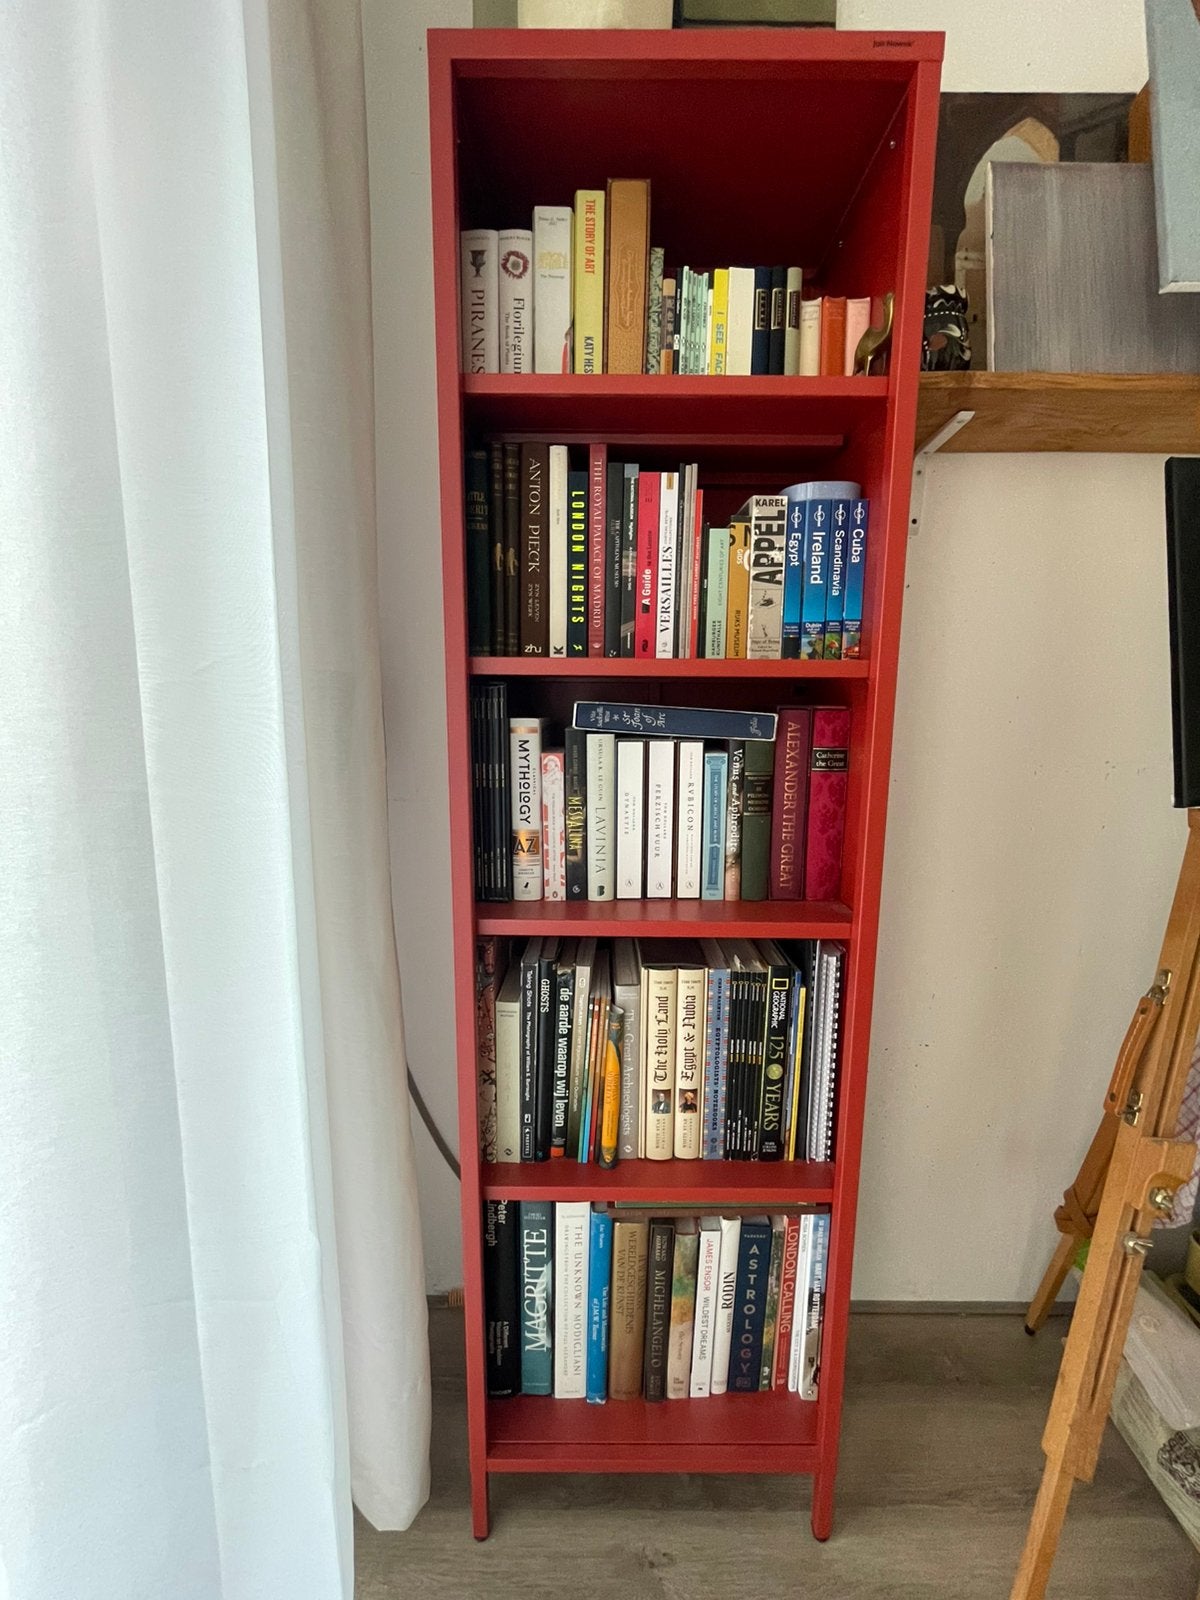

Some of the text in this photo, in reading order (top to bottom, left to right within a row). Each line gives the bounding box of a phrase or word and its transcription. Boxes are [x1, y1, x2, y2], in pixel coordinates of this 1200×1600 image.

[584, 199, 596, 275] THE STORY OF ART
[583, 336, 594, 357] KATY
[715, 323, 725, 345] SEE
[528, 458, 541, 573] ANTON PIECK
[755, 498, 786, 507] KAREL
[571, 490, 585, 623] LONDON NIGHTS
[592, 459, 603, 628] THE ROYAL PALACE OF MADRID
[736, 548, 744, 565] GIDS
[752, 510, 786, 585] APPEL
[788, 532, 802, 567] Egypt
[810, 531, 826, 585] Ireland
[832, 530, 845, 596] Scandinavia
[851, 528, 865, 563] Cuba
[642, 569, 652, 596] Guide
[642, 598, 651, 606] A
[660, 545, 673, 633] VERSAILLES
[631, 708, 643, 730] Joan
[657, 712, 666, 728] Arc
[732, 749, 743, 780] Venus
[816, 751, 845, 759] Catherine
[518, 740, 531, 825] MYTHOLOGY
[568, 796, 583, 850] MESSALINA
[729, 798, 740, 852] Aphrodite
[779, 721, 801, 890] ALEXANDER THE GREAT
[595, 807, 606, 874] LAVINIA
[525, 969, 533, 989] Taking
[525, 989, 533, 1007] Shots
[541, 978, 550, 1013] GHOSTS
[655, 995, 669, 1026] Land
[682, 995, 696, 1029] Nubia
[771, 991, 780, 1029] GEOGRAPHIC
[779, 991, 787, 1020] NATIONAL
[554, 987, 572, 1128] de aarde waarop wij leven
[654, 1029, 671, 1055] Holy
[684, 1032, 695, 1043] &
[769, 1035, 784, 1060] 125
[621, 1009, 634, 1136] The Great Archaeologists
[653, 1059, 668, 1083] The
[681, 1046, 697, 1082] Egypt
[763, 1083, 782, 1131] YEARS
[486, 1200, 498, 1247] indbergh
[523, 1229, 547, 1352] MAGRITTE
[573, 1224, 583, 1376] THE UNKNOWN MODIGLIANI
[615, 1249, 626, 1316] VAN DE KUNST
[625, 1231, 637, 1334] WERELDGESCHIEDENIS
[698, 1238, 714, 1361] JAMES ENSOR WILDEST DREAMS
[721, 1271, 735, 1309] RODIN
[780, 1225, 799, 1333] LONDON CALLING
[651, 1270, 666, 1368] MICHELANGELO
[741, 1244, 759, 1373] ASTROLOGY
